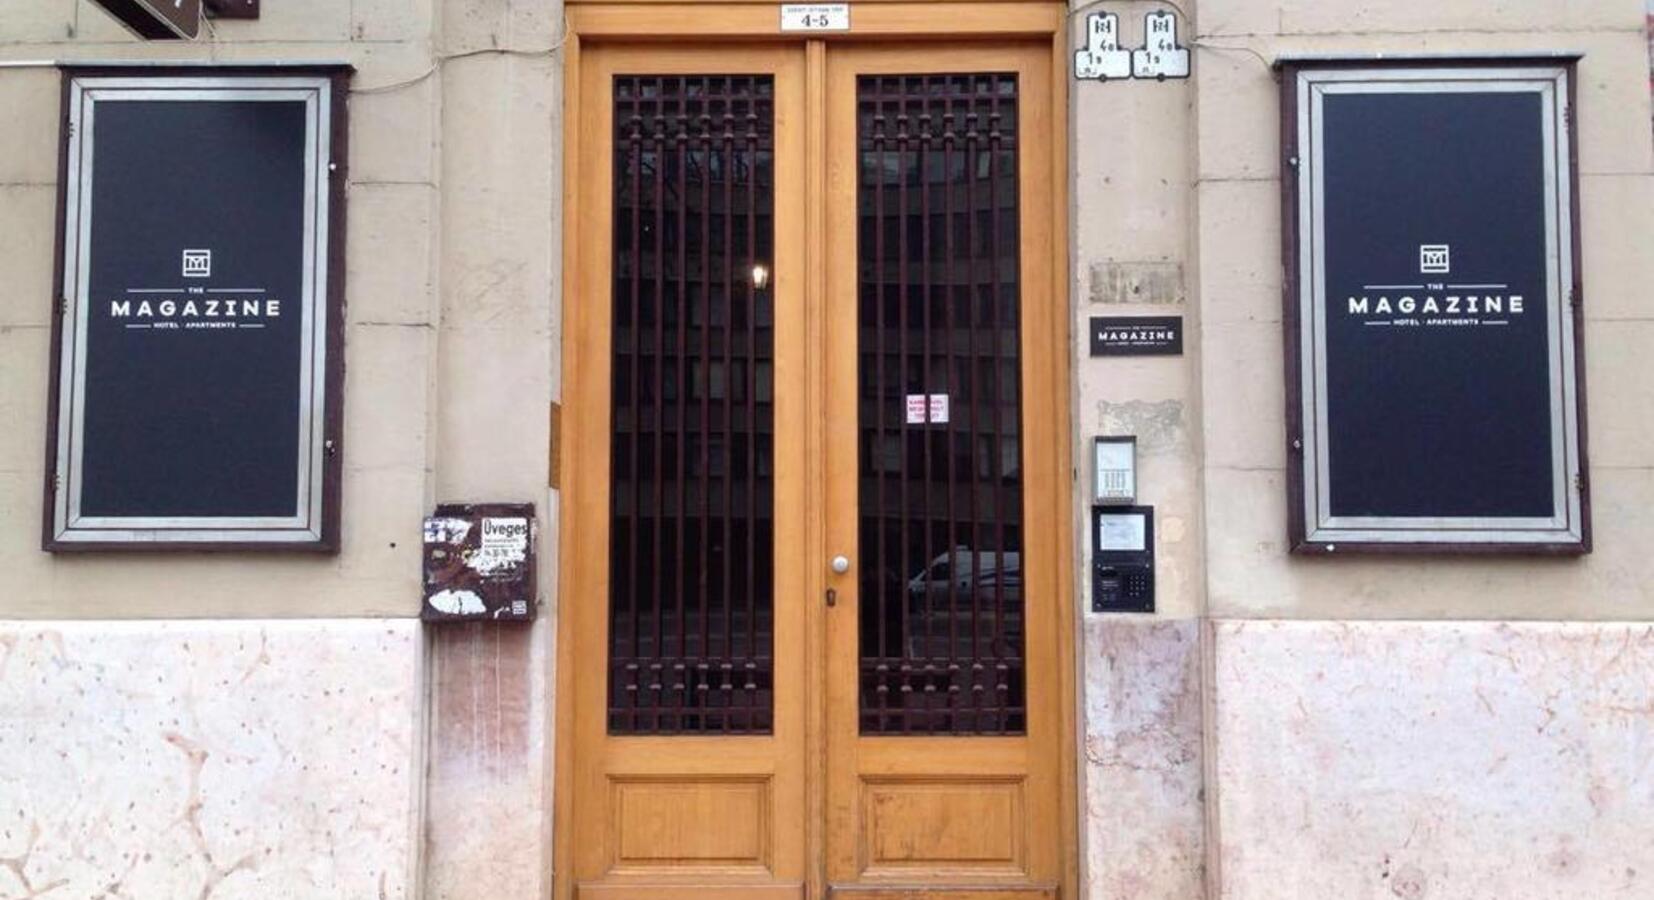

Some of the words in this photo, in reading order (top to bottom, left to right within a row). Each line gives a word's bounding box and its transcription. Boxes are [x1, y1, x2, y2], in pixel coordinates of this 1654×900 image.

[801, 14, 829, 27] 4-5
[1427, 283, 1444, 291] THE
[111, 300, 281, 317] MAGAZINE
[1348, 296, 1524, 314] MAGAZINE
[185, 321, 237, 329] APARTMENTS
[1426, 318, 1479, 326] APARTMENTS
[1098, 331, 1175, 341] MAGAZINE
